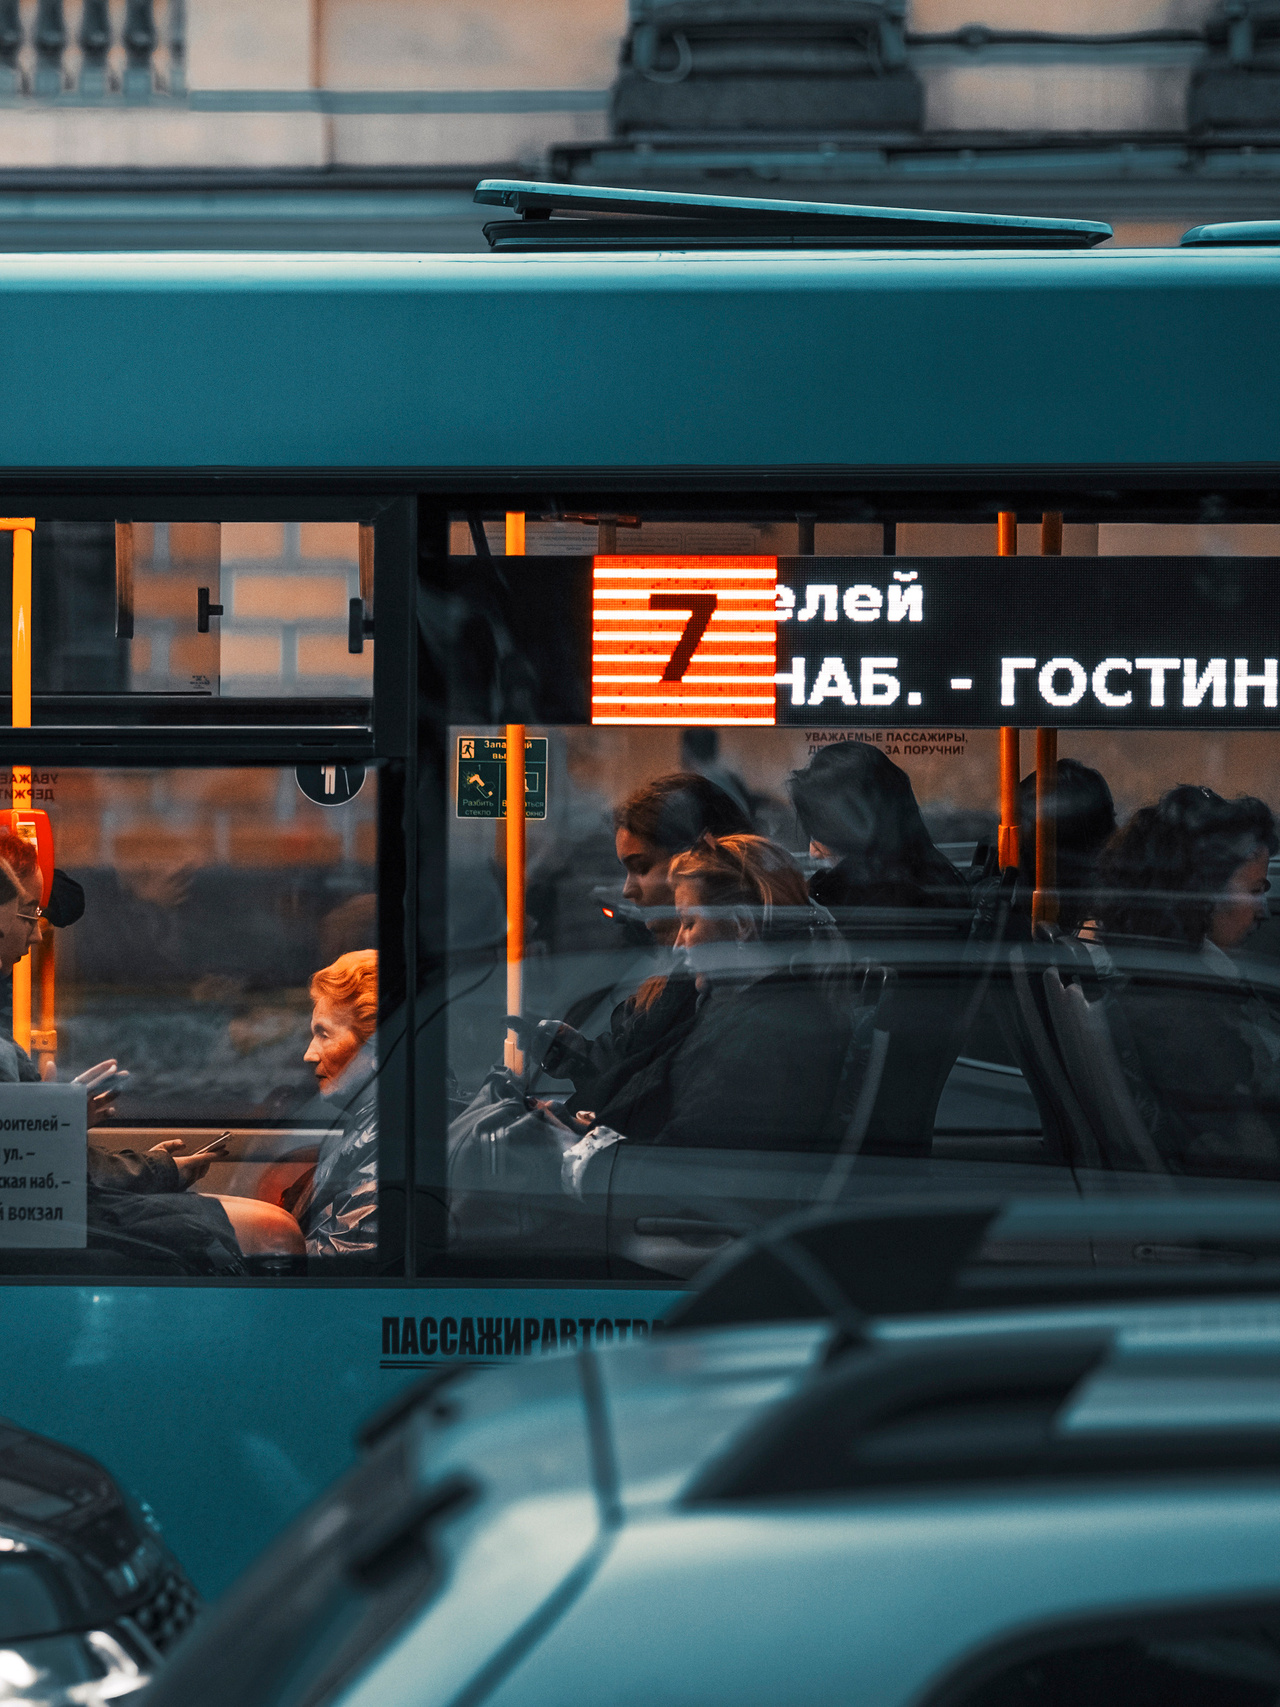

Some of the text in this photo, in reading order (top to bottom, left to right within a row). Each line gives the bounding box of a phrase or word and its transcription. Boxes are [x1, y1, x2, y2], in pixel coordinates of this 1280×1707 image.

[648, 593, 718, 683] 7
[1000, 656, 1279, 707] ГОСТИН
[805, 732, 968, 744] УВАЖАЕМЫЕ ПАССАЖИРЫ,
[885, 745, 964, 755] ЗА ПОРУЧНИ!
[462, 799, 494, 807] Разбить
[3, 1147, 23, 1165] ул.
[30, 1172, 59, 1189] наб.
[8, 1205, 64, 1222] вокзал
